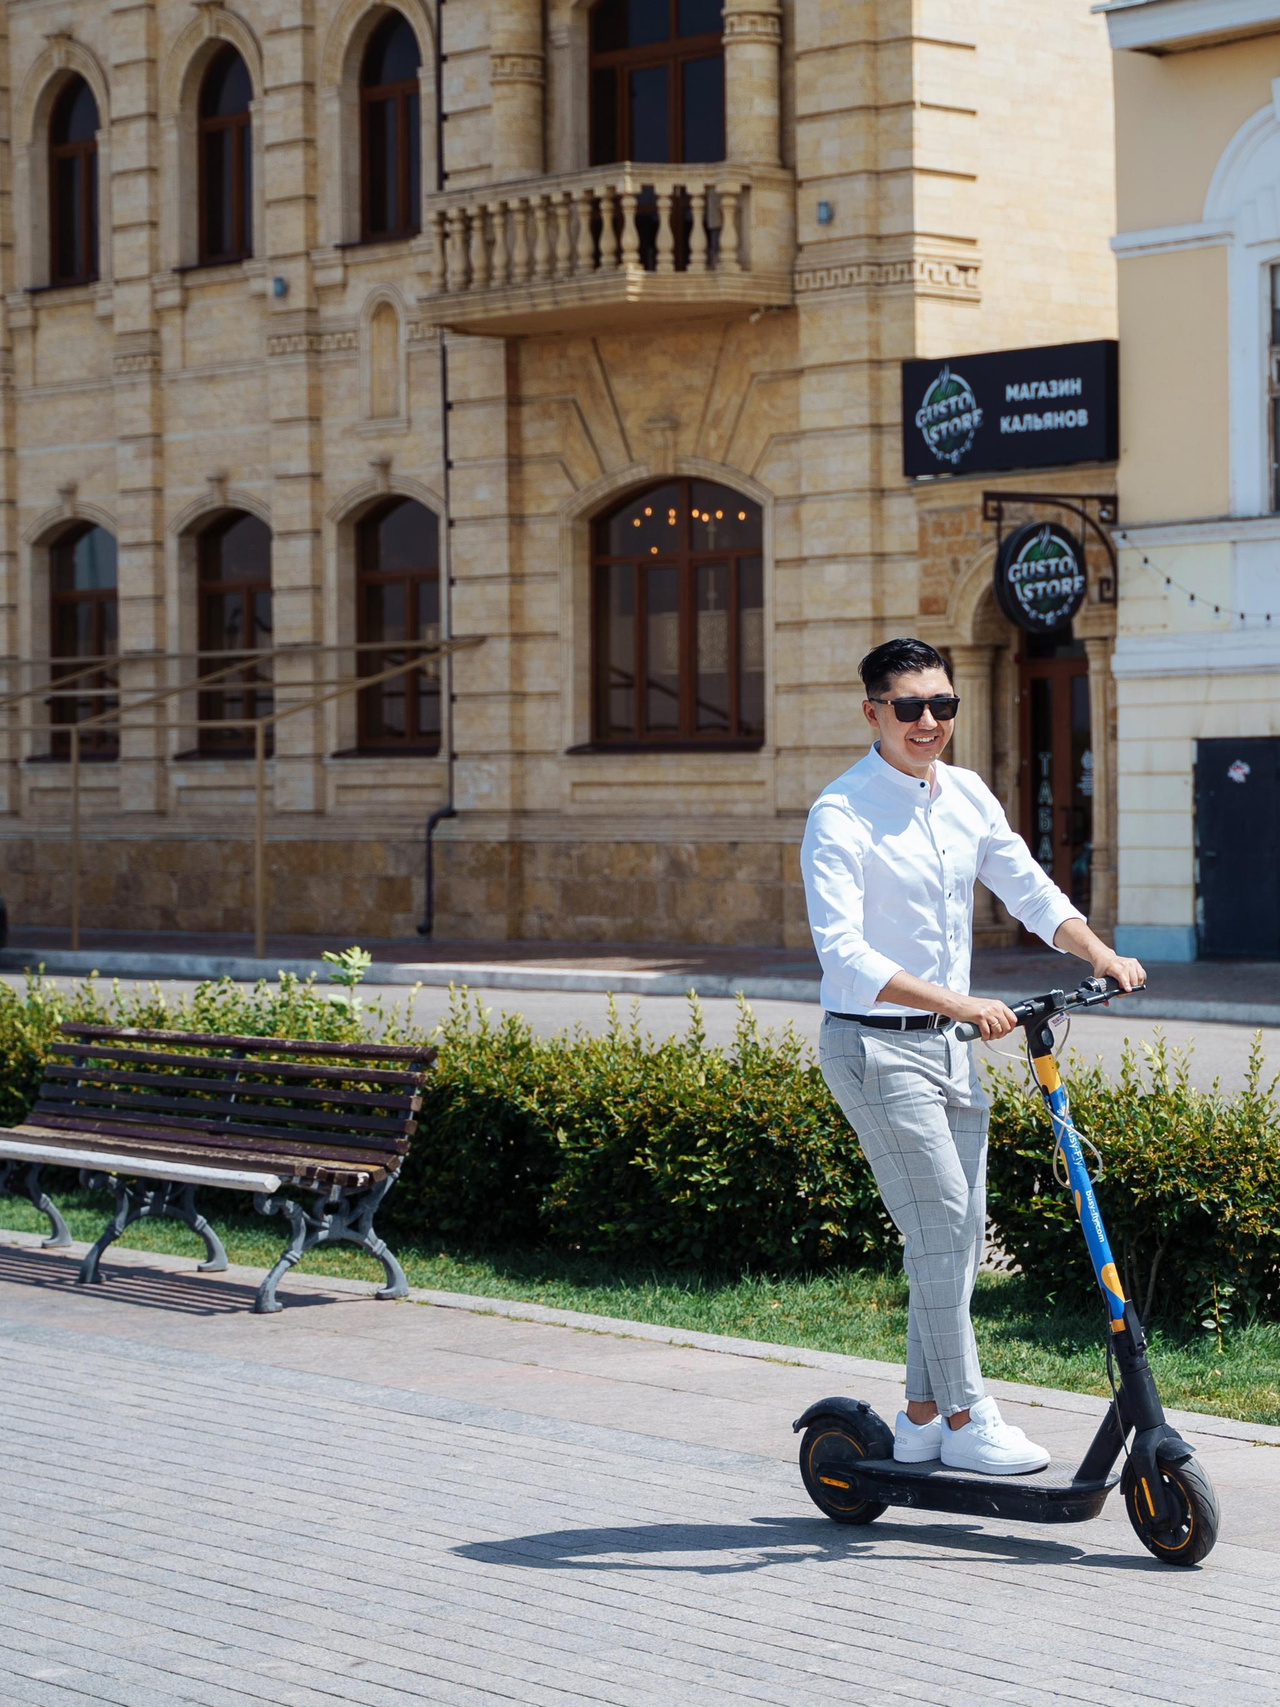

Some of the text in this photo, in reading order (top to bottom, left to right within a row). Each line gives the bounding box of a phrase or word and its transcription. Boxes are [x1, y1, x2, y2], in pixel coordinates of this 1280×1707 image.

[1005, 377, 1082, 402] МАГАЗИН
[915, 391, 972, 428] GUSTO
[1000, 408, 1088, 434] КАЛЬЯНОВ
[928, 409, 984, 445] STORE
[1008, 556, 1073, 583] GUSTO
[1021, 574, 1085, 600] STORE
